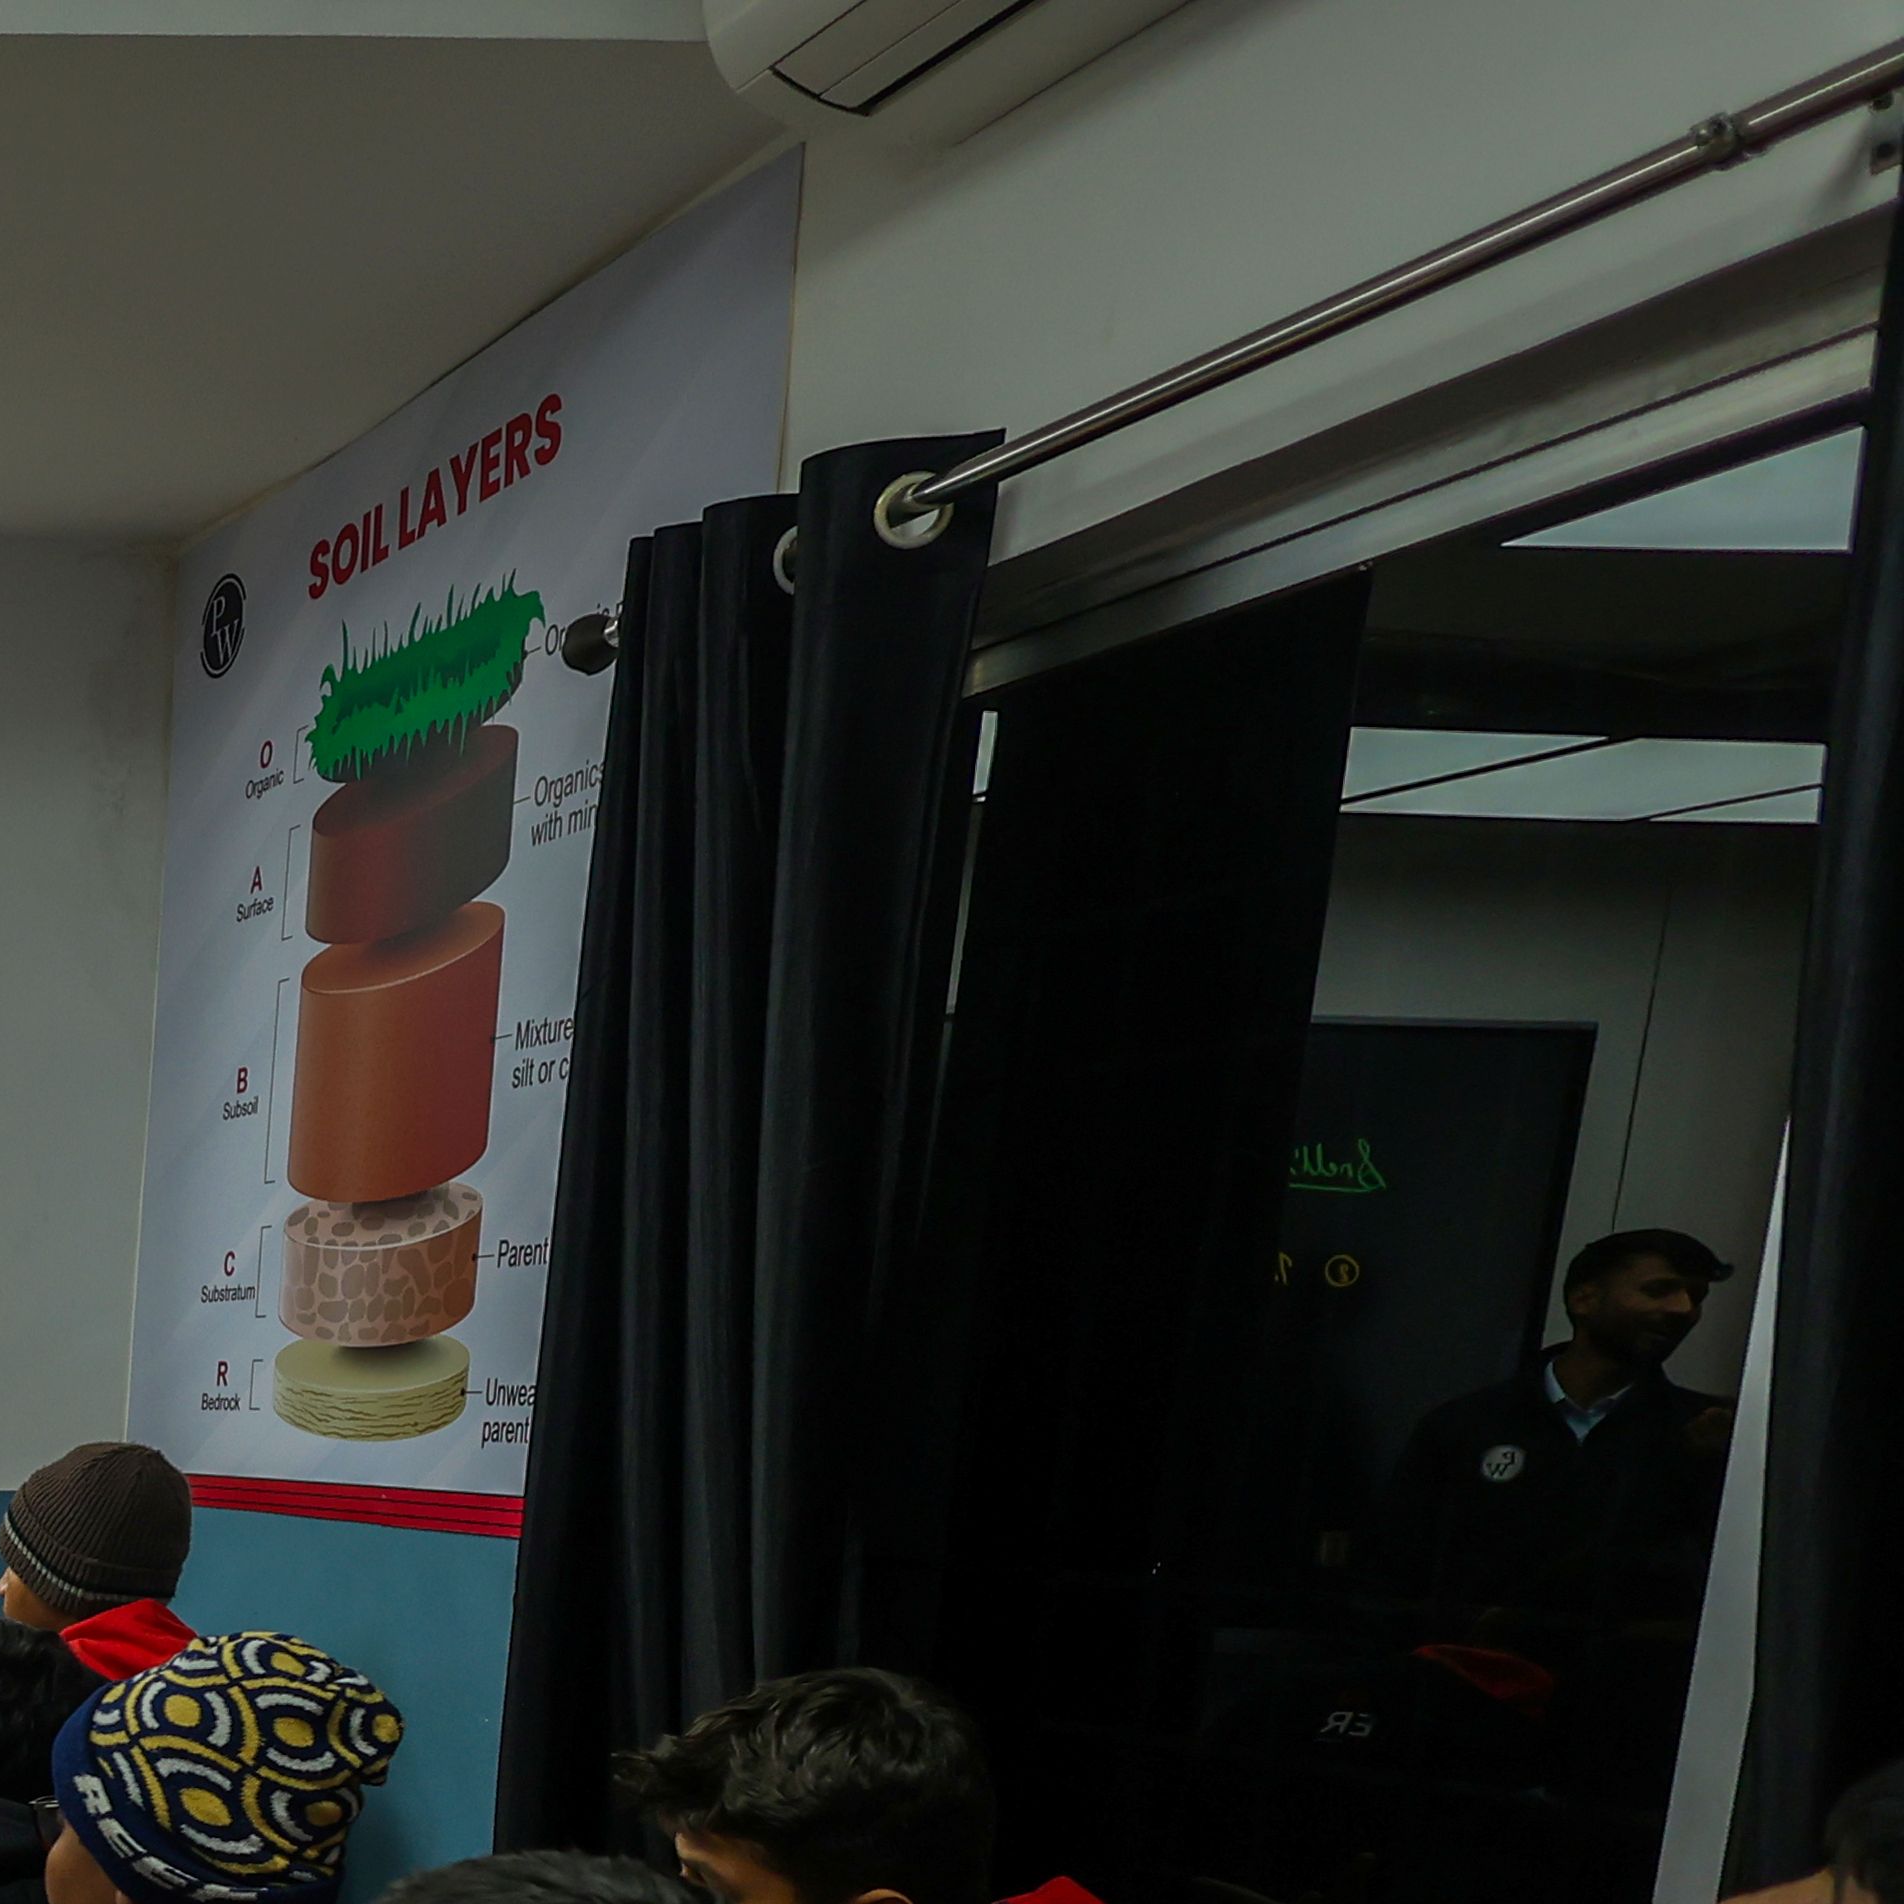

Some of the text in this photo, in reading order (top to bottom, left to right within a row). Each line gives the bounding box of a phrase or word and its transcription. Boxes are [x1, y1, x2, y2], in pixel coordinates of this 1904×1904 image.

[309, 394, 562, 599] SOIL LAYERS
[260, 740, 273, 769] O
[245, 768, 285, 799] Organic
[531, 810, 563, 847] with
[250, 866, 263, 895] A
[236, 897, 275, 923] Surface
[515, 1017, 574, 1051] Mixture
[237, 1066, 249, 1095] B
[512, 1058, 534, 1089] silt
[538, 1060, 555, 1084] or
[222, 1096, 259, 1121] Subsoil
[224, 1250, 236, 1277] C
[497, 1236, 549, 1269] Parent
[200, 1284, 256, 1304] Substratum
[217, 1360, 229, 1387] R
[201, 1392, 241, 1411] Bedrock
[481, 1416, 530, 1450] parent
